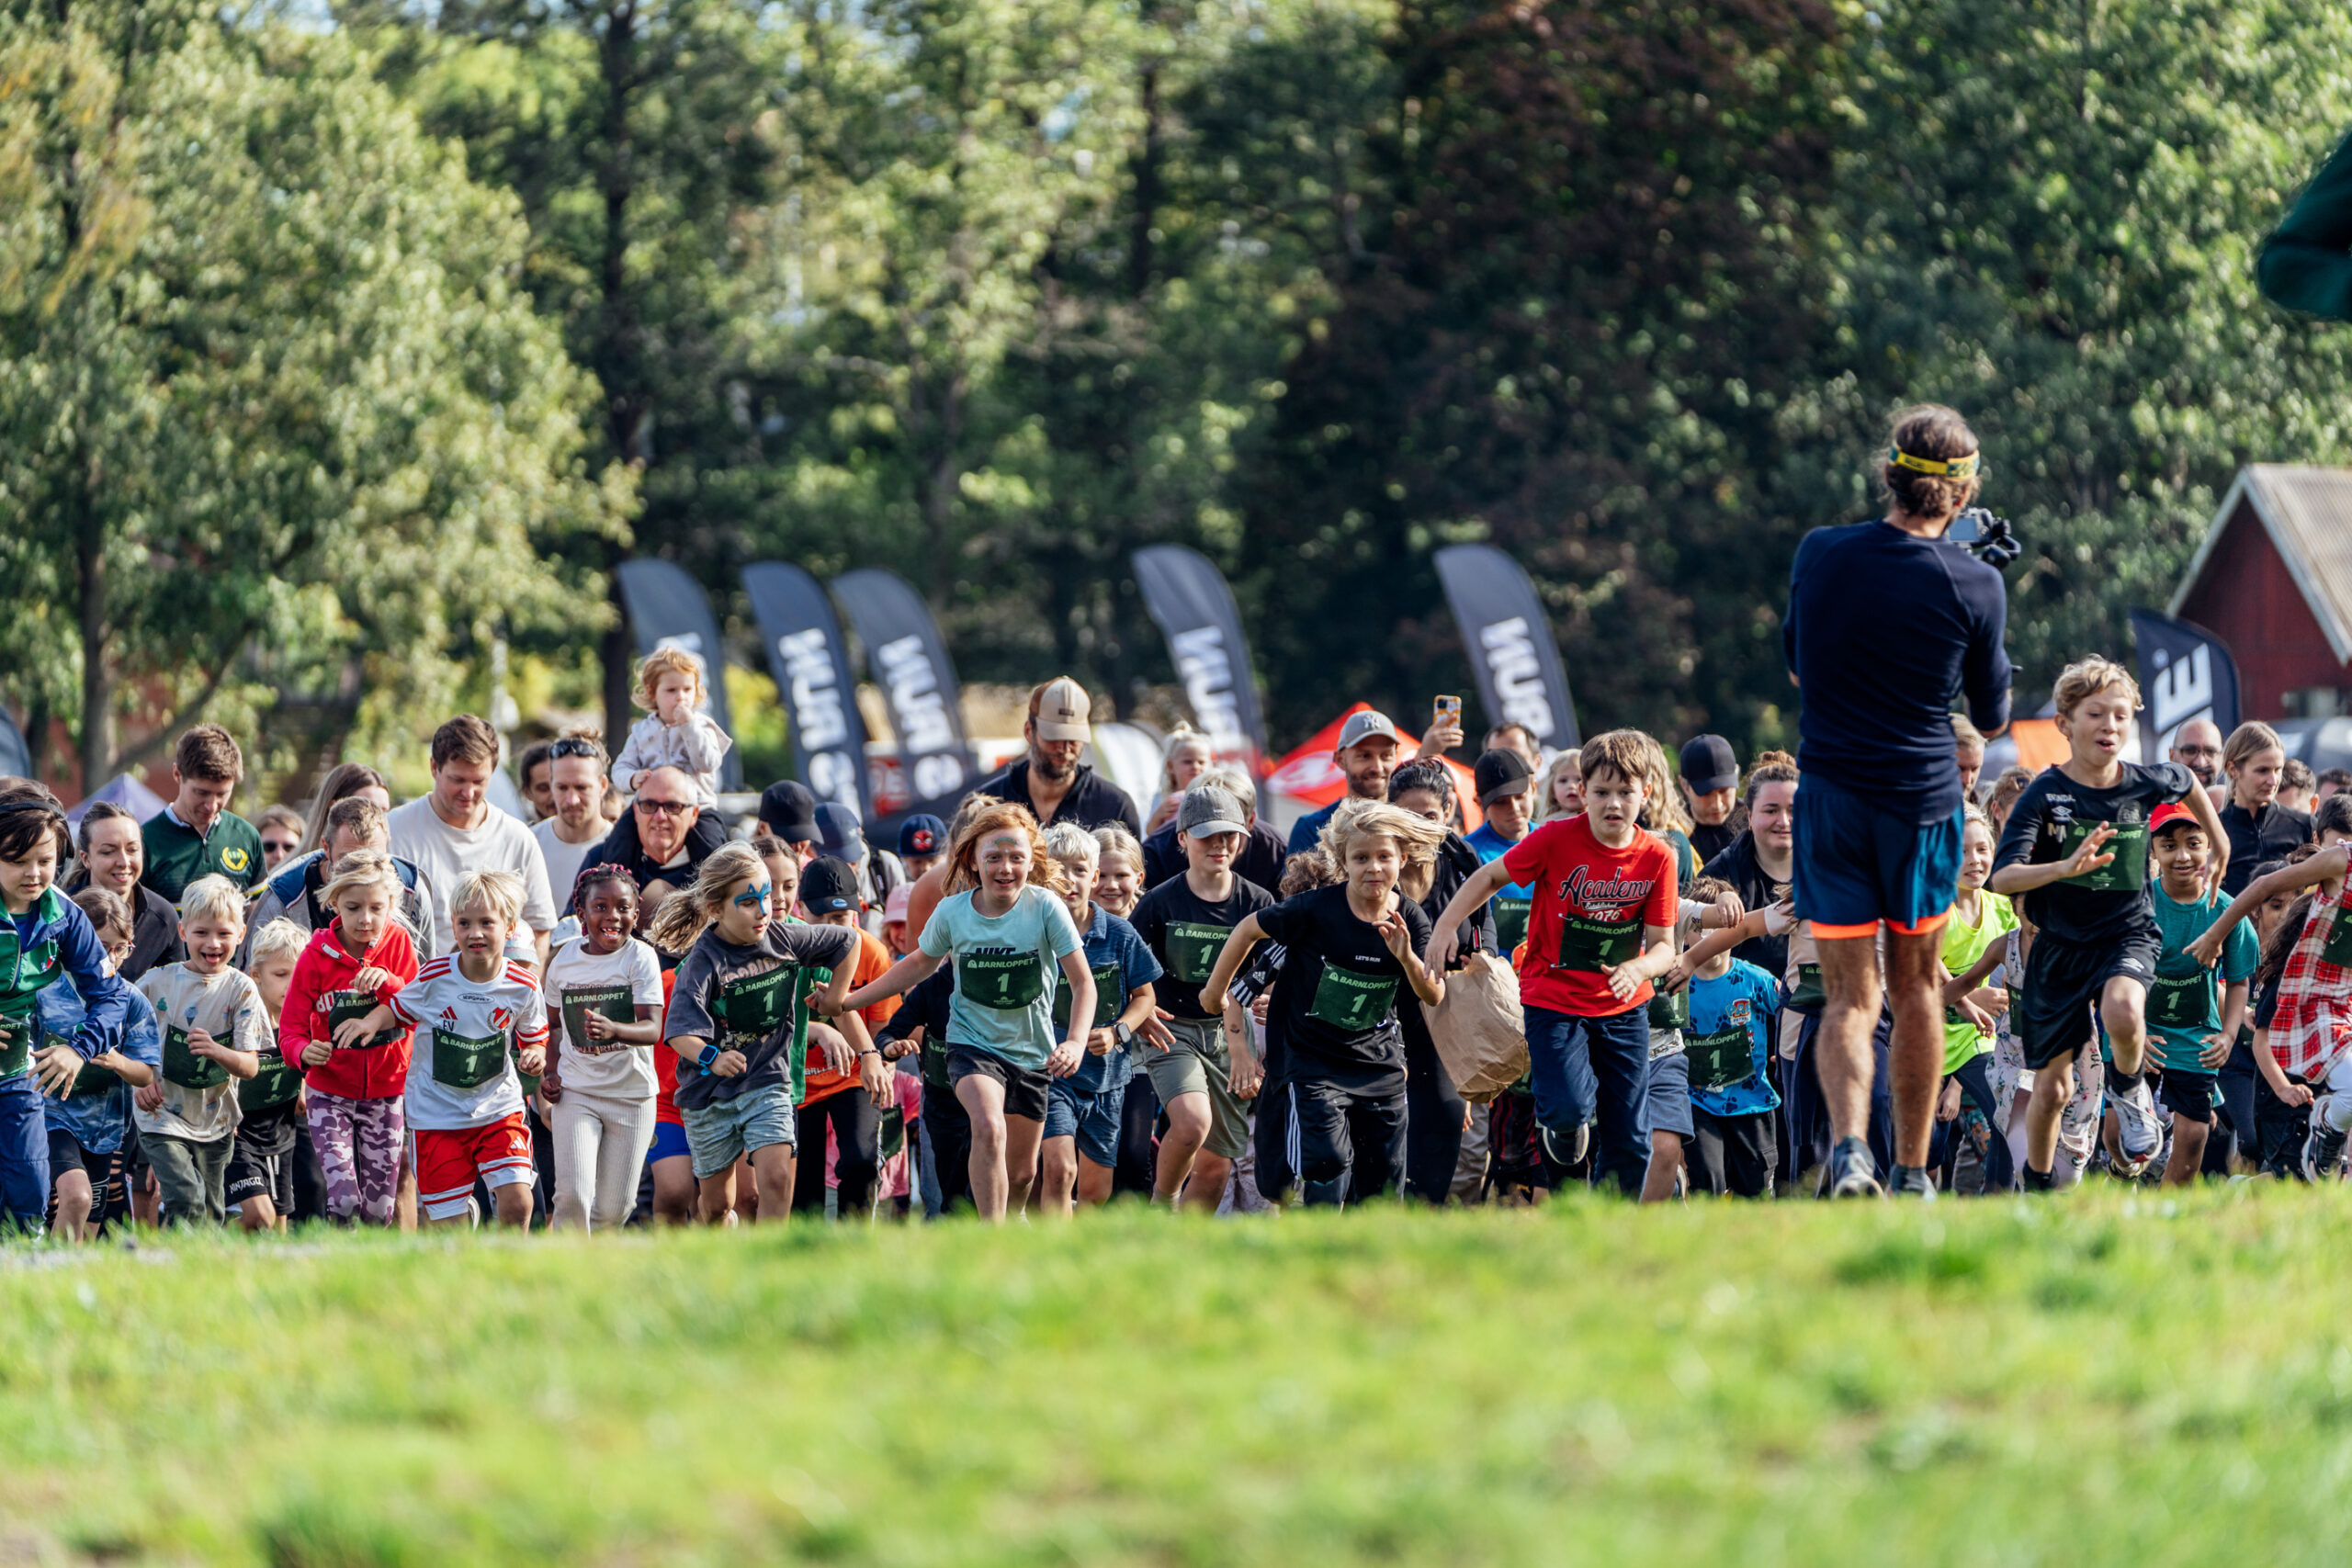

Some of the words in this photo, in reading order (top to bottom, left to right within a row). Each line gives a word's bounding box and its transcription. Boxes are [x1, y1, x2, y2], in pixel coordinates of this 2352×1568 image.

[1185, 930, 1231, 941] BARNLOPP
[1583, 922, 1639, 935] BARNLOPPET
[1200, 944, 1214, 965] 1
[1599, 939, 1614, 956] 1
[978, 957, 1036, 968] BARNLOPPET
[745, 970, 790, 992] BARNLOPPET
[997, 973, 1010, 993] 1
[1339, 976, 1393, 989] BARNLOPPET
[2156, 975, 2202, 987] ARNLOPPET
[572, 992, 626, 1003] BARNLOPPET
[763, 990, 774, 1013] 1
[1351, 993, 1368, 1013] 1
[2166, 991, 2181, 1010] 1
[449, 1037, 502, 1051] BARNLOPPET
[1692, 1031, 1742, 1046] BARNLOPPET
[196, 1055, 208, 1073] 1
[465, 1055, 478, 1074] 1
[1709, 1049, 1721, 1070] 1
[270, 1072, 282, 1092] 1
[229, 1176, 266, 1194] NINJAGO
